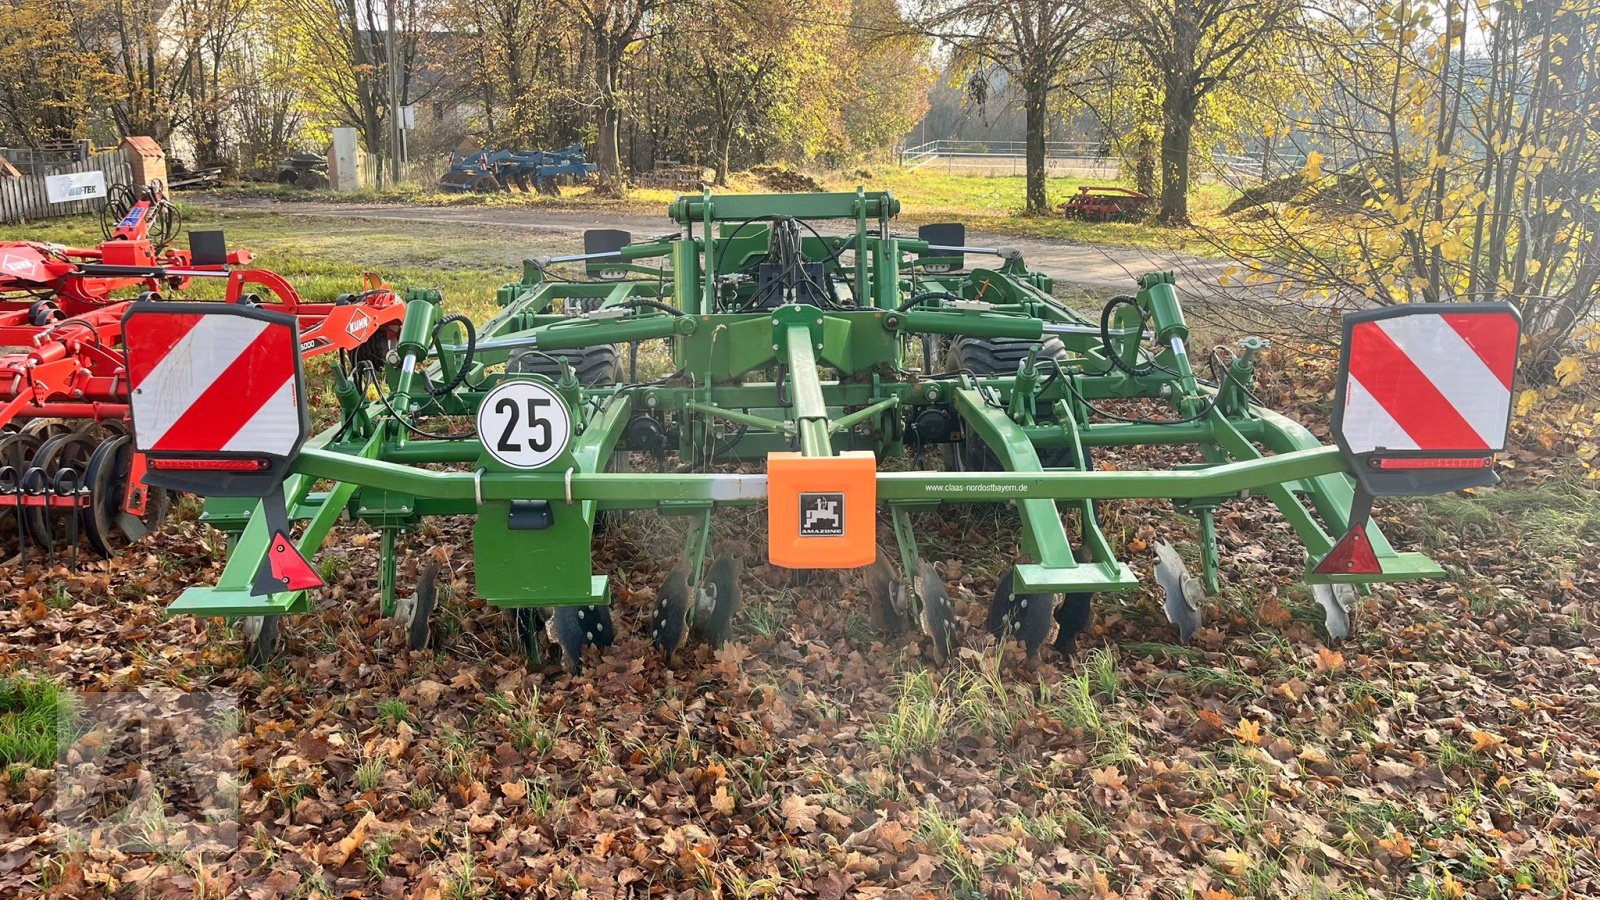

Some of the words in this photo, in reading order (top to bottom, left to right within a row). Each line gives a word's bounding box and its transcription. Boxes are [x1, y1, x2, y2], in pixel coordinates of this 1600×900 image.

[349, 317, 369, 334] KUHN
[495, 398, 552, 453] 25
[925, 483, 1028, 493] www.claas-nordostbayern.de
